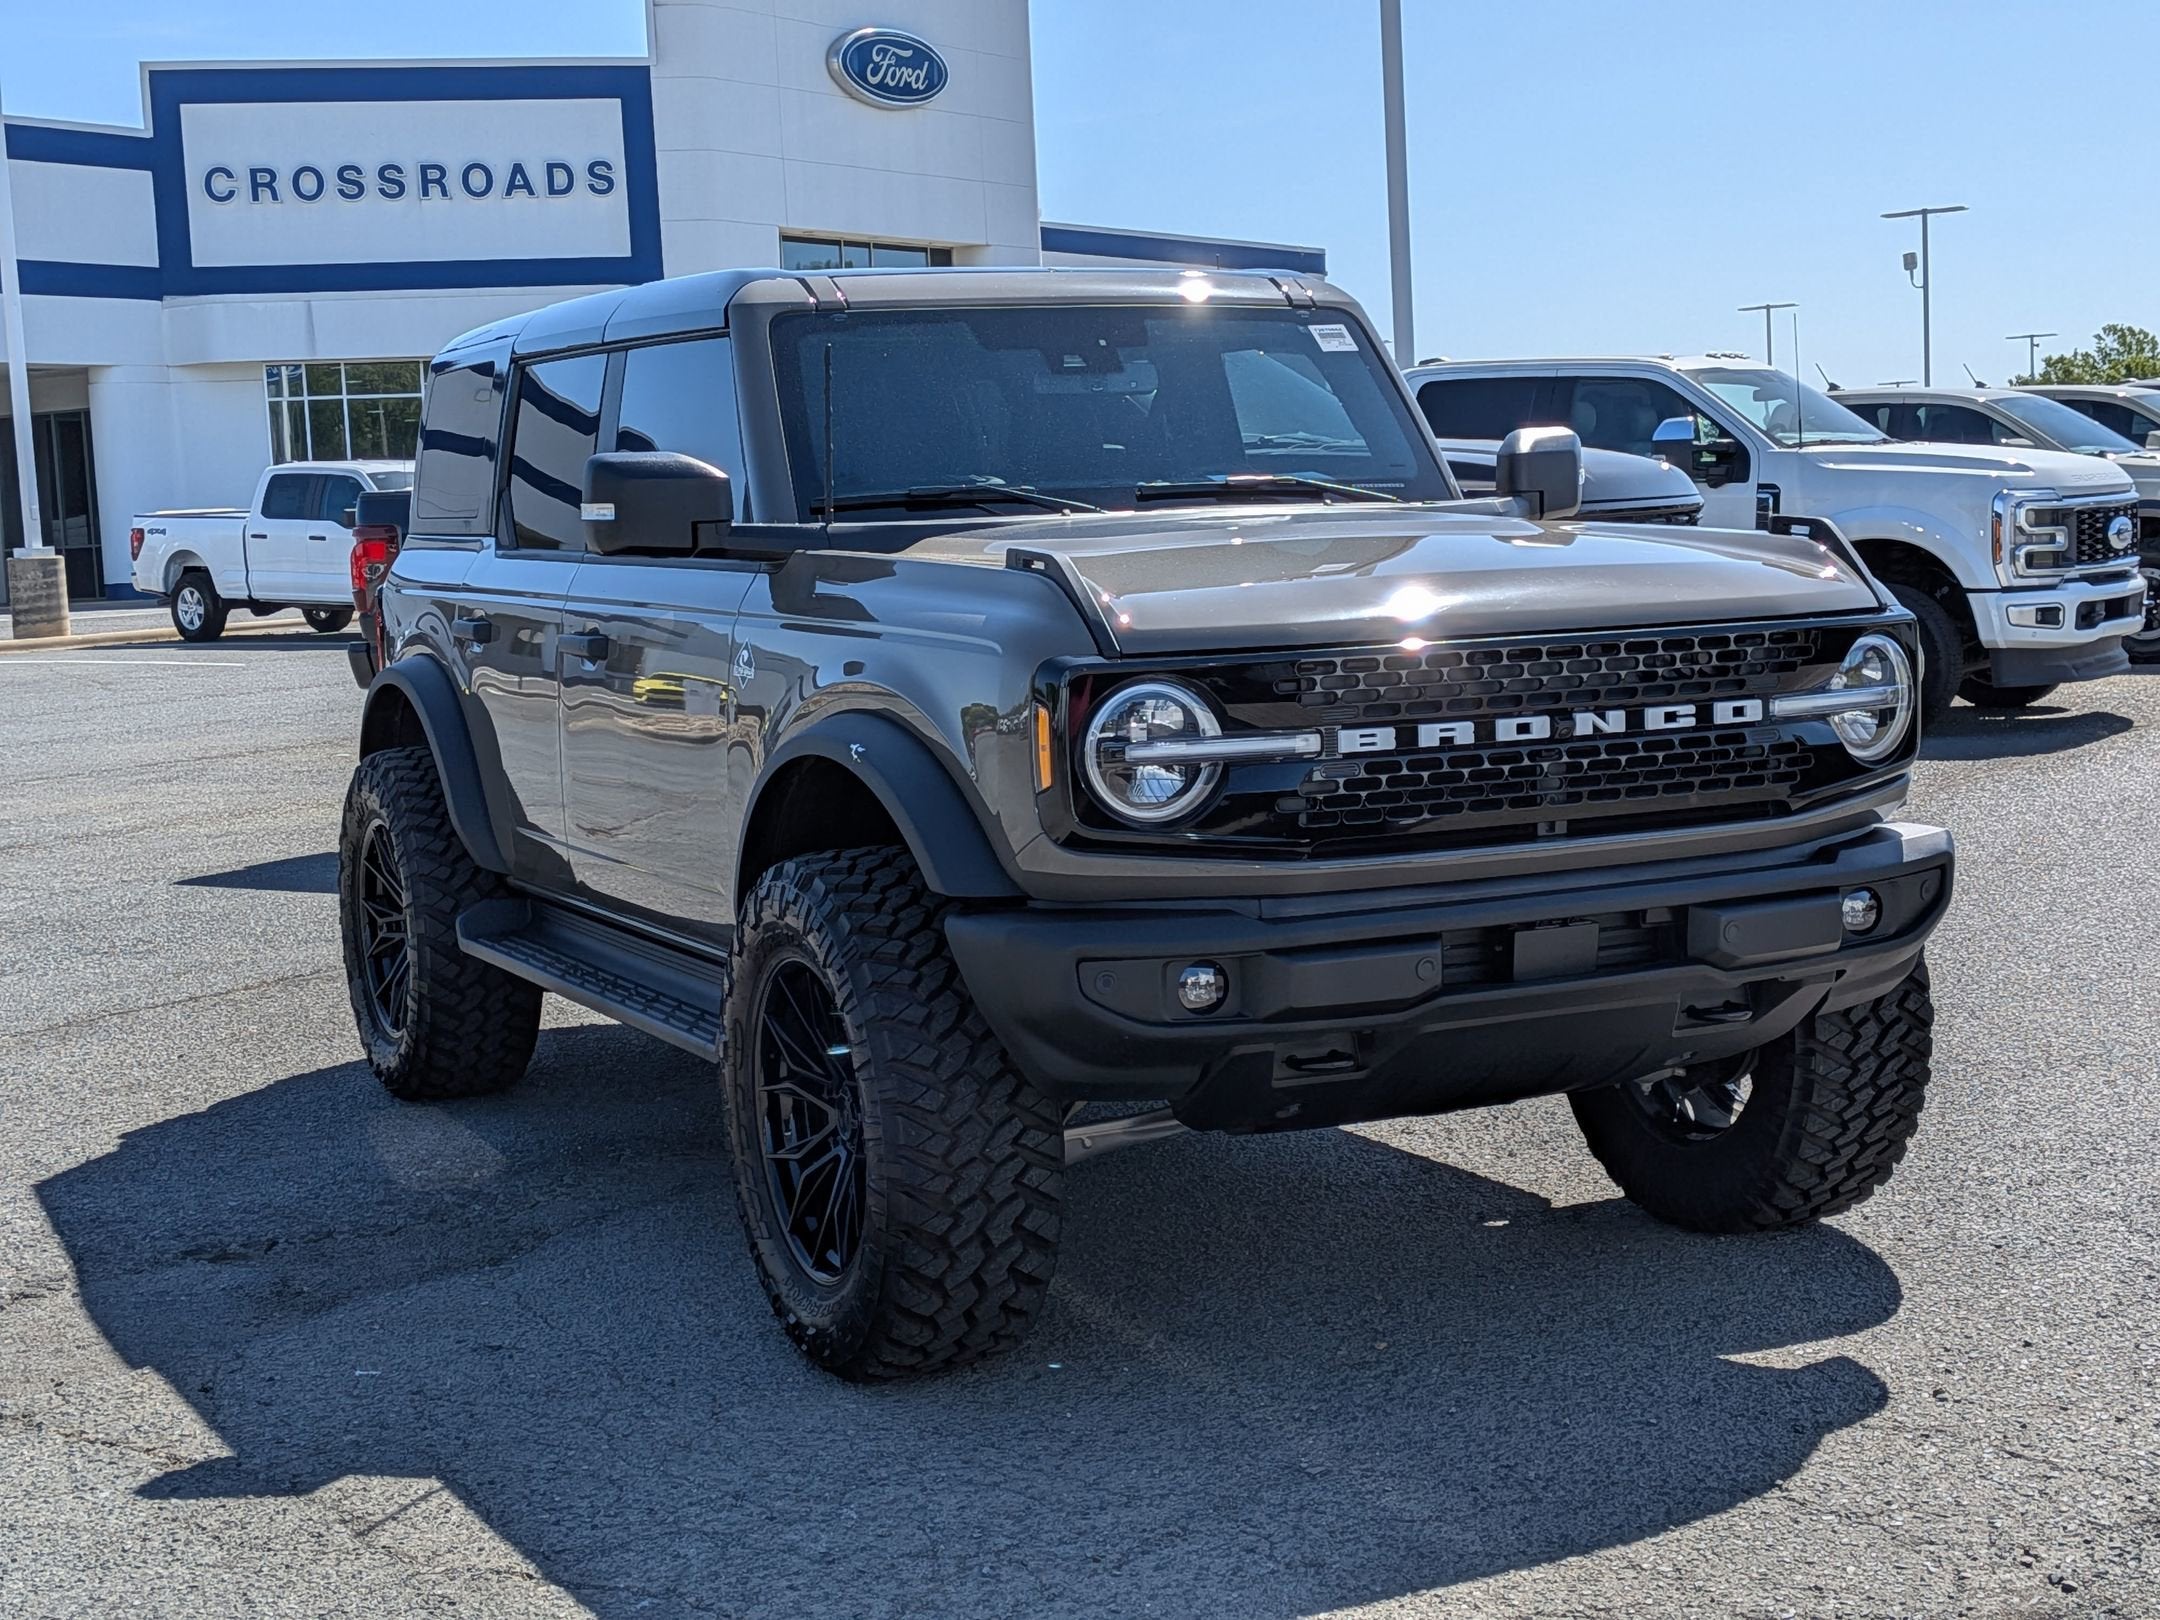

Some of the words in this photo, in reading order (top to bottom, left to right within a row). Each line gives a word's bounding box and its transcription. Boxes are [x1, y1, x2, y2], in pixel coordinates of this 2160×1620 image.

[866, 44, 929, 90] Ford
[203, 160, 616, 203] CROSSROADS
[1337, 699, 1763, 754] BRONCO
